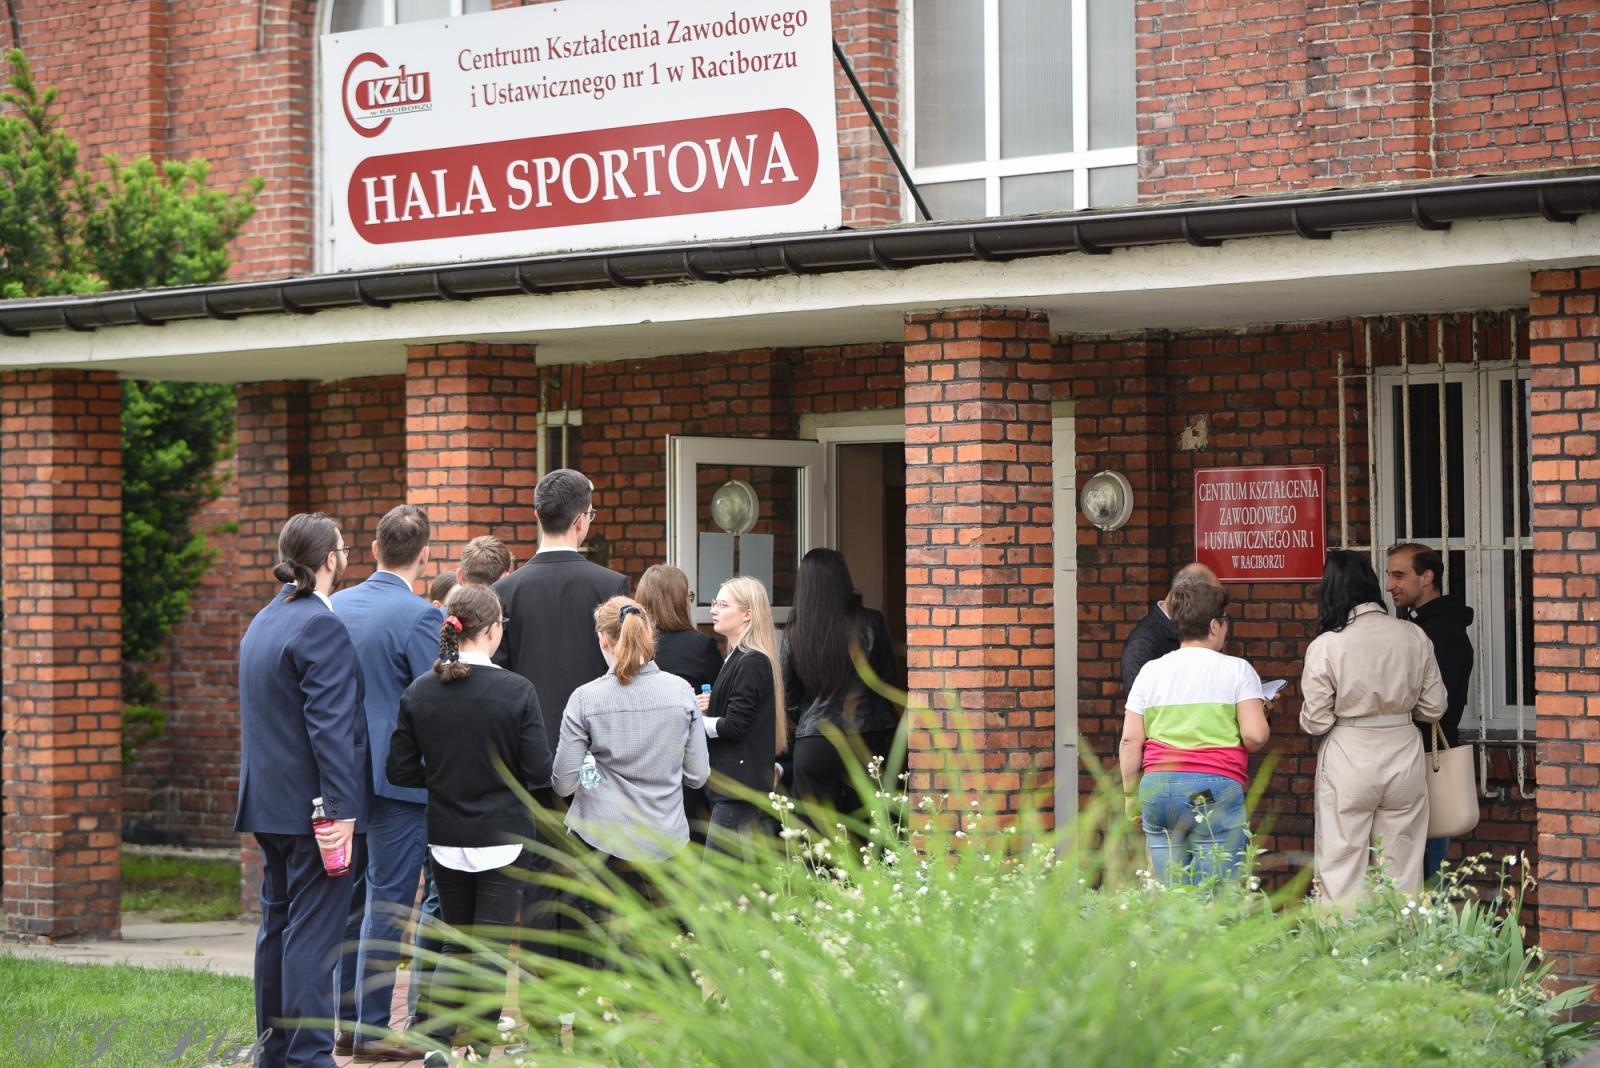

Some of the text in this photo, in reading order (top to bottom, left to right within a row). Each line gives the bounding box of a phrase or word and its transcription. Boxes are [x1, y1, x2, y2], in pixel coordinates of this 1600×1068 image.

[458, 9, 808, 72] Centrum Kształcenia Zawodowego
[470, 49, 798, 108] i Ustawicznego nr 1 w Raciborzu
[361, 130, 800, 226] HALA SPORTOWA
[1198, 479, 1319, 502] CENTRUM KSZTAŁCENIA
[1219, 505, 1297, 526] ZAWODOWEGO
[1204, 529, 1315, 550] I USTAWICZNEGO NR 1
[1231, 554, 1285, 569] W RACIBORZU
